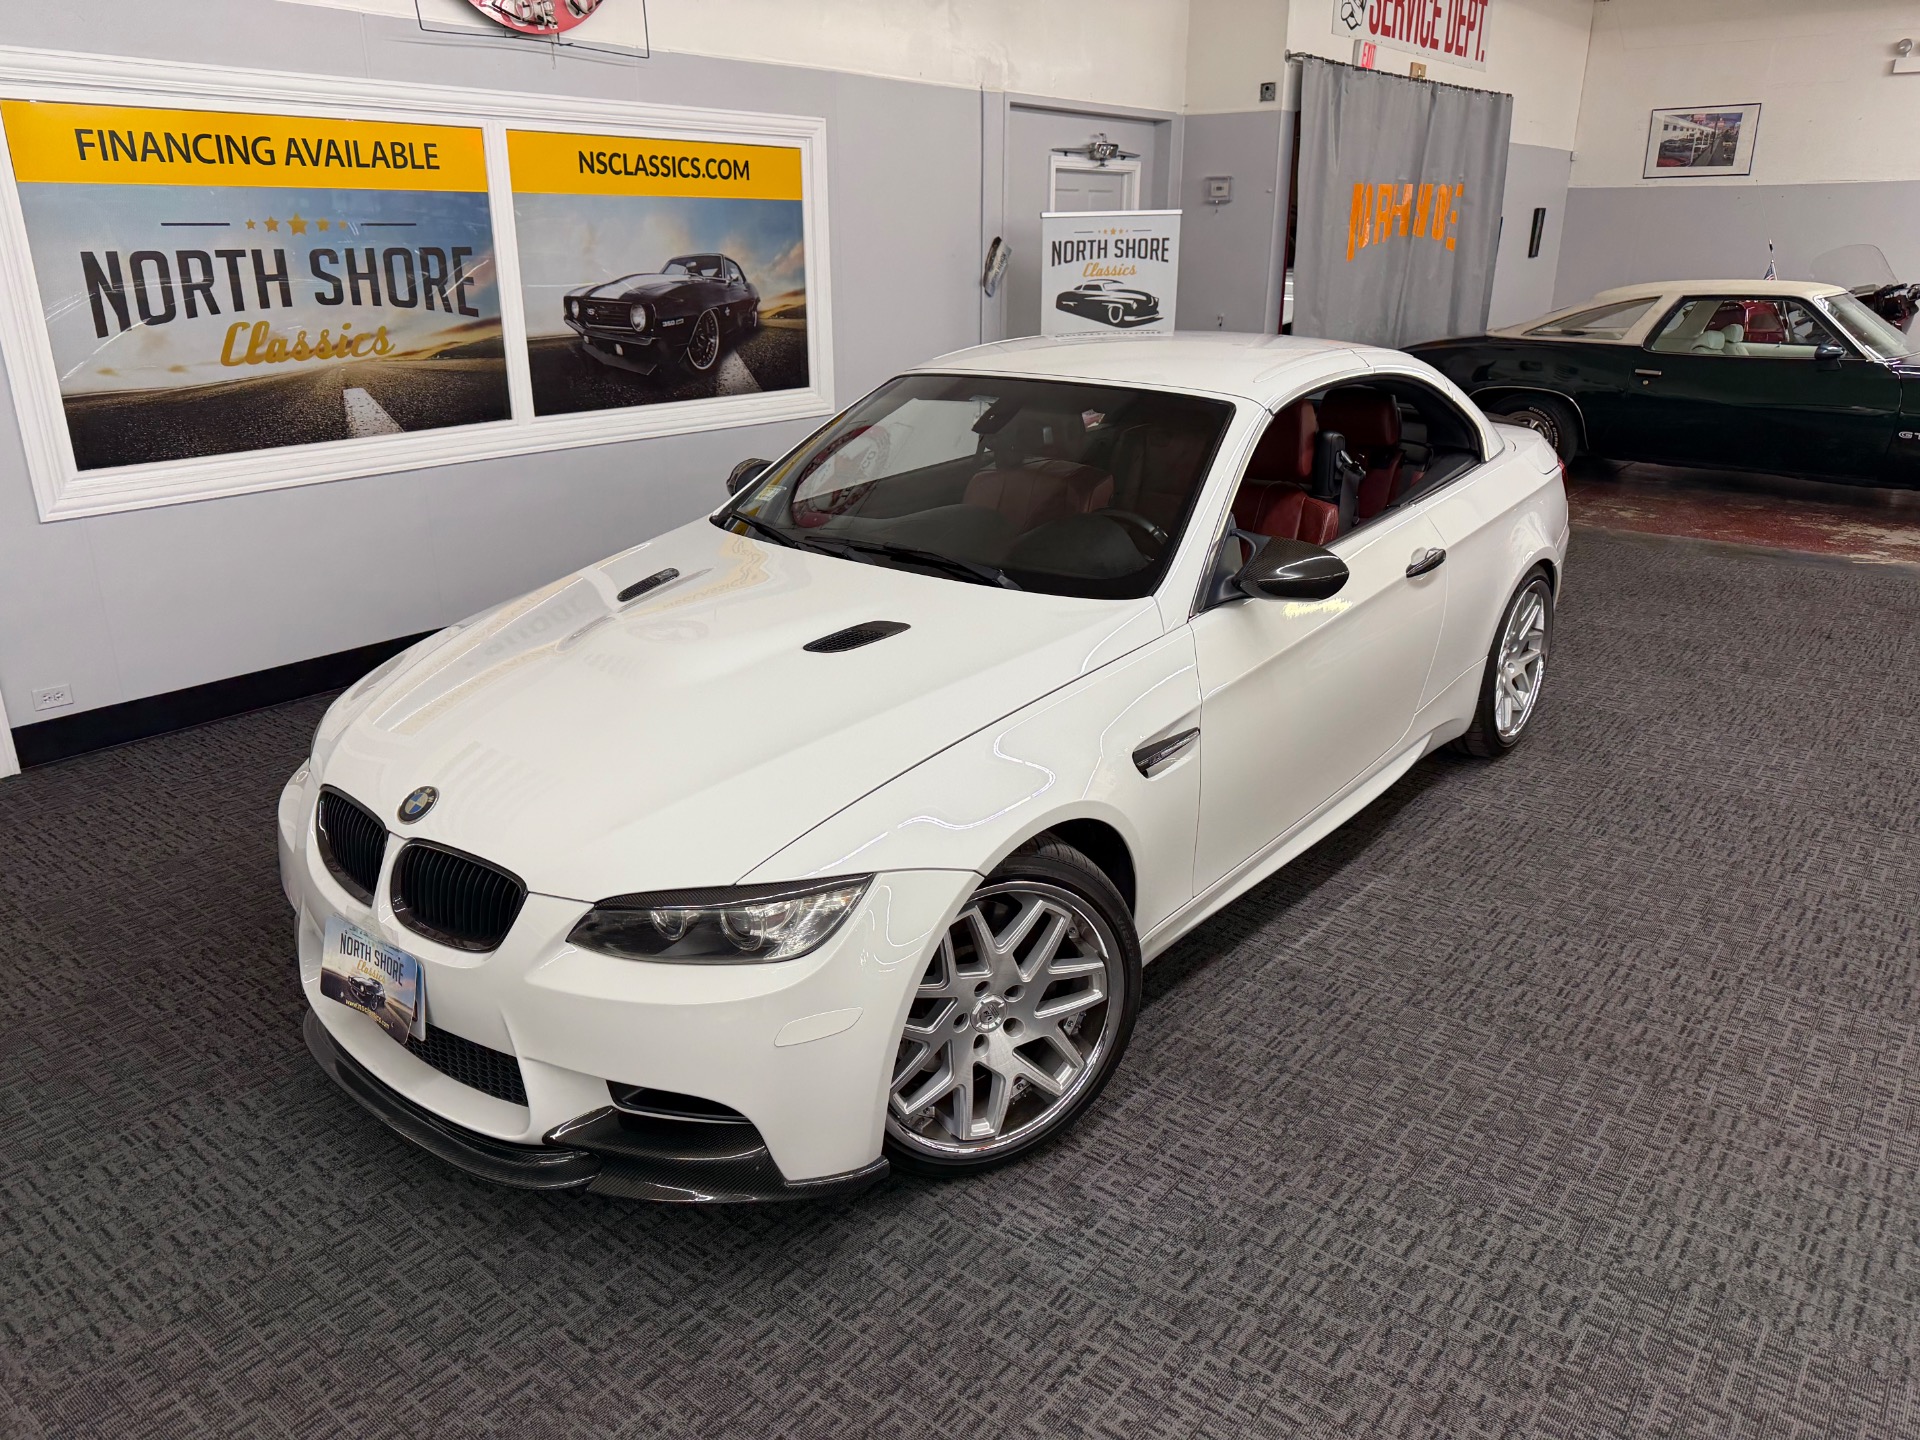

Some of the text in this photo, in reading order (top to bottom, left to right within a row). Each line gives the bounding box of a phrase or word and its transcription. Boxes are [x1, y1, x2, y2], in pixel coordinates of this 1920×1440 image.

[1368, 0, 1488, 63] SERVICE DEPT.
[74, 128, 441, 171] FINANCING AVAILABLE
[578, 150, 750, 181] NSCLASSICS.COM
[1051, 237, 1170, 267] NORTH SHORE
[1082, 262, 1137, 278] Classics
[80, 246, 480, 340] NORTH SHORE
[219, 319, 396, 368] Classics
[339, 932, 405, 987] NORTH SHORE
[356, 959, 386, 983] Classics
